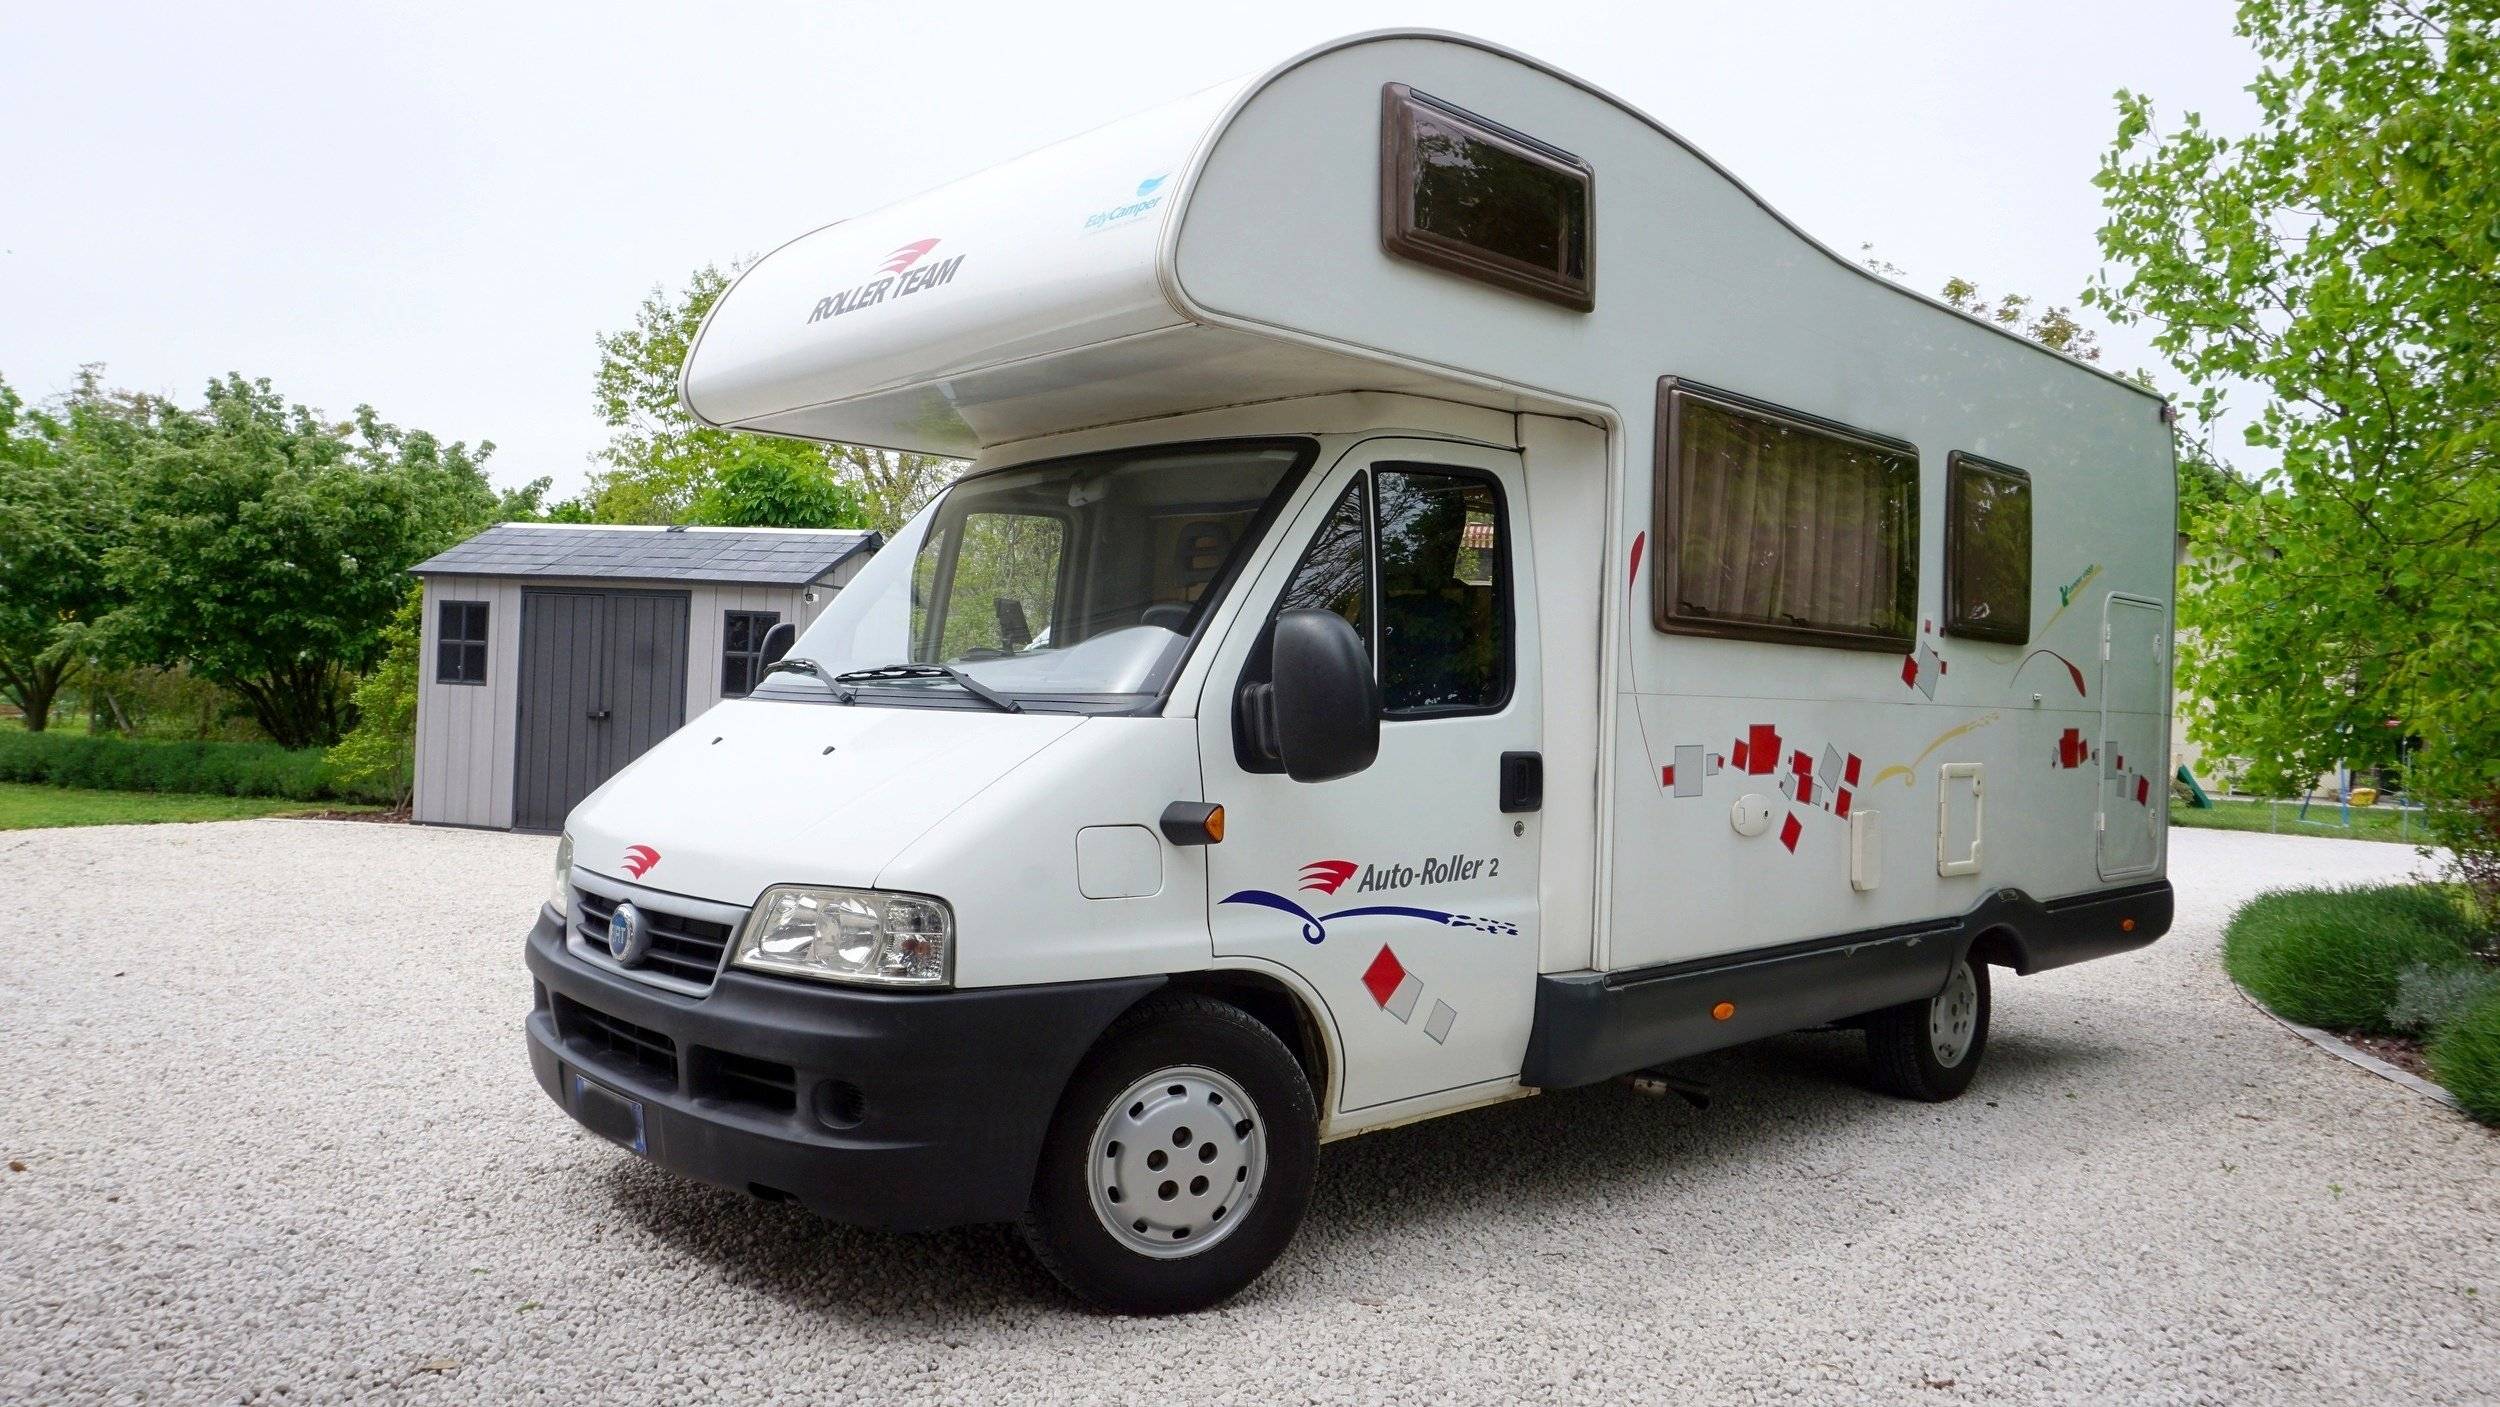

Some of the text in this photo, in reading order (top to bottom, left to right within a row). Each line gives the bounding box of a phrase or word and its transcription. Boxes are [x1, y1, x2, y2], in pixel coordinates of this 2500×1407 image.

[806, 254, 967, 325] ROLLER TEAM
[1357, 854, 1500, 893] Auto-Roller 2
